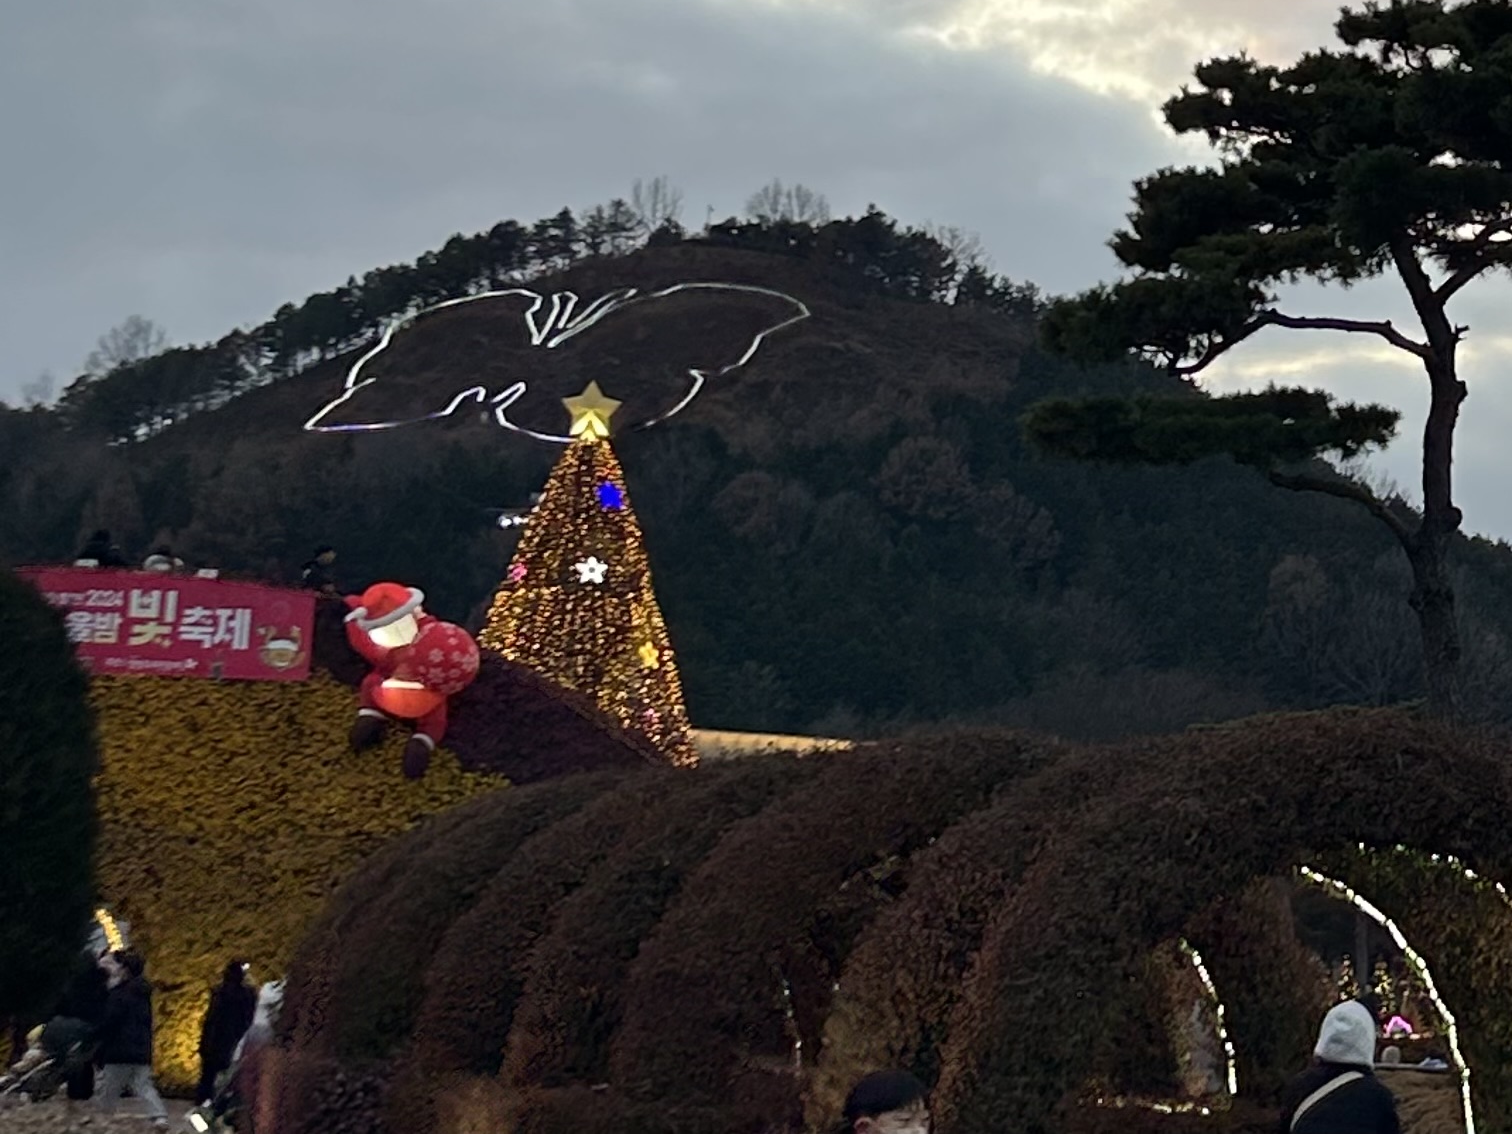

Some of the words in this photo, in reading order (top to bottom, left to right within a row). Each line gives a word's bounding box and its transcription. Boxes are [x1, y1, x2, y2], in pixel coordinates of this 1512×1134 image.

[65, 610, 123, 644] 울밤
[128, 588, 179, 648] 빛
[177, 606, 252, 650] 축제
